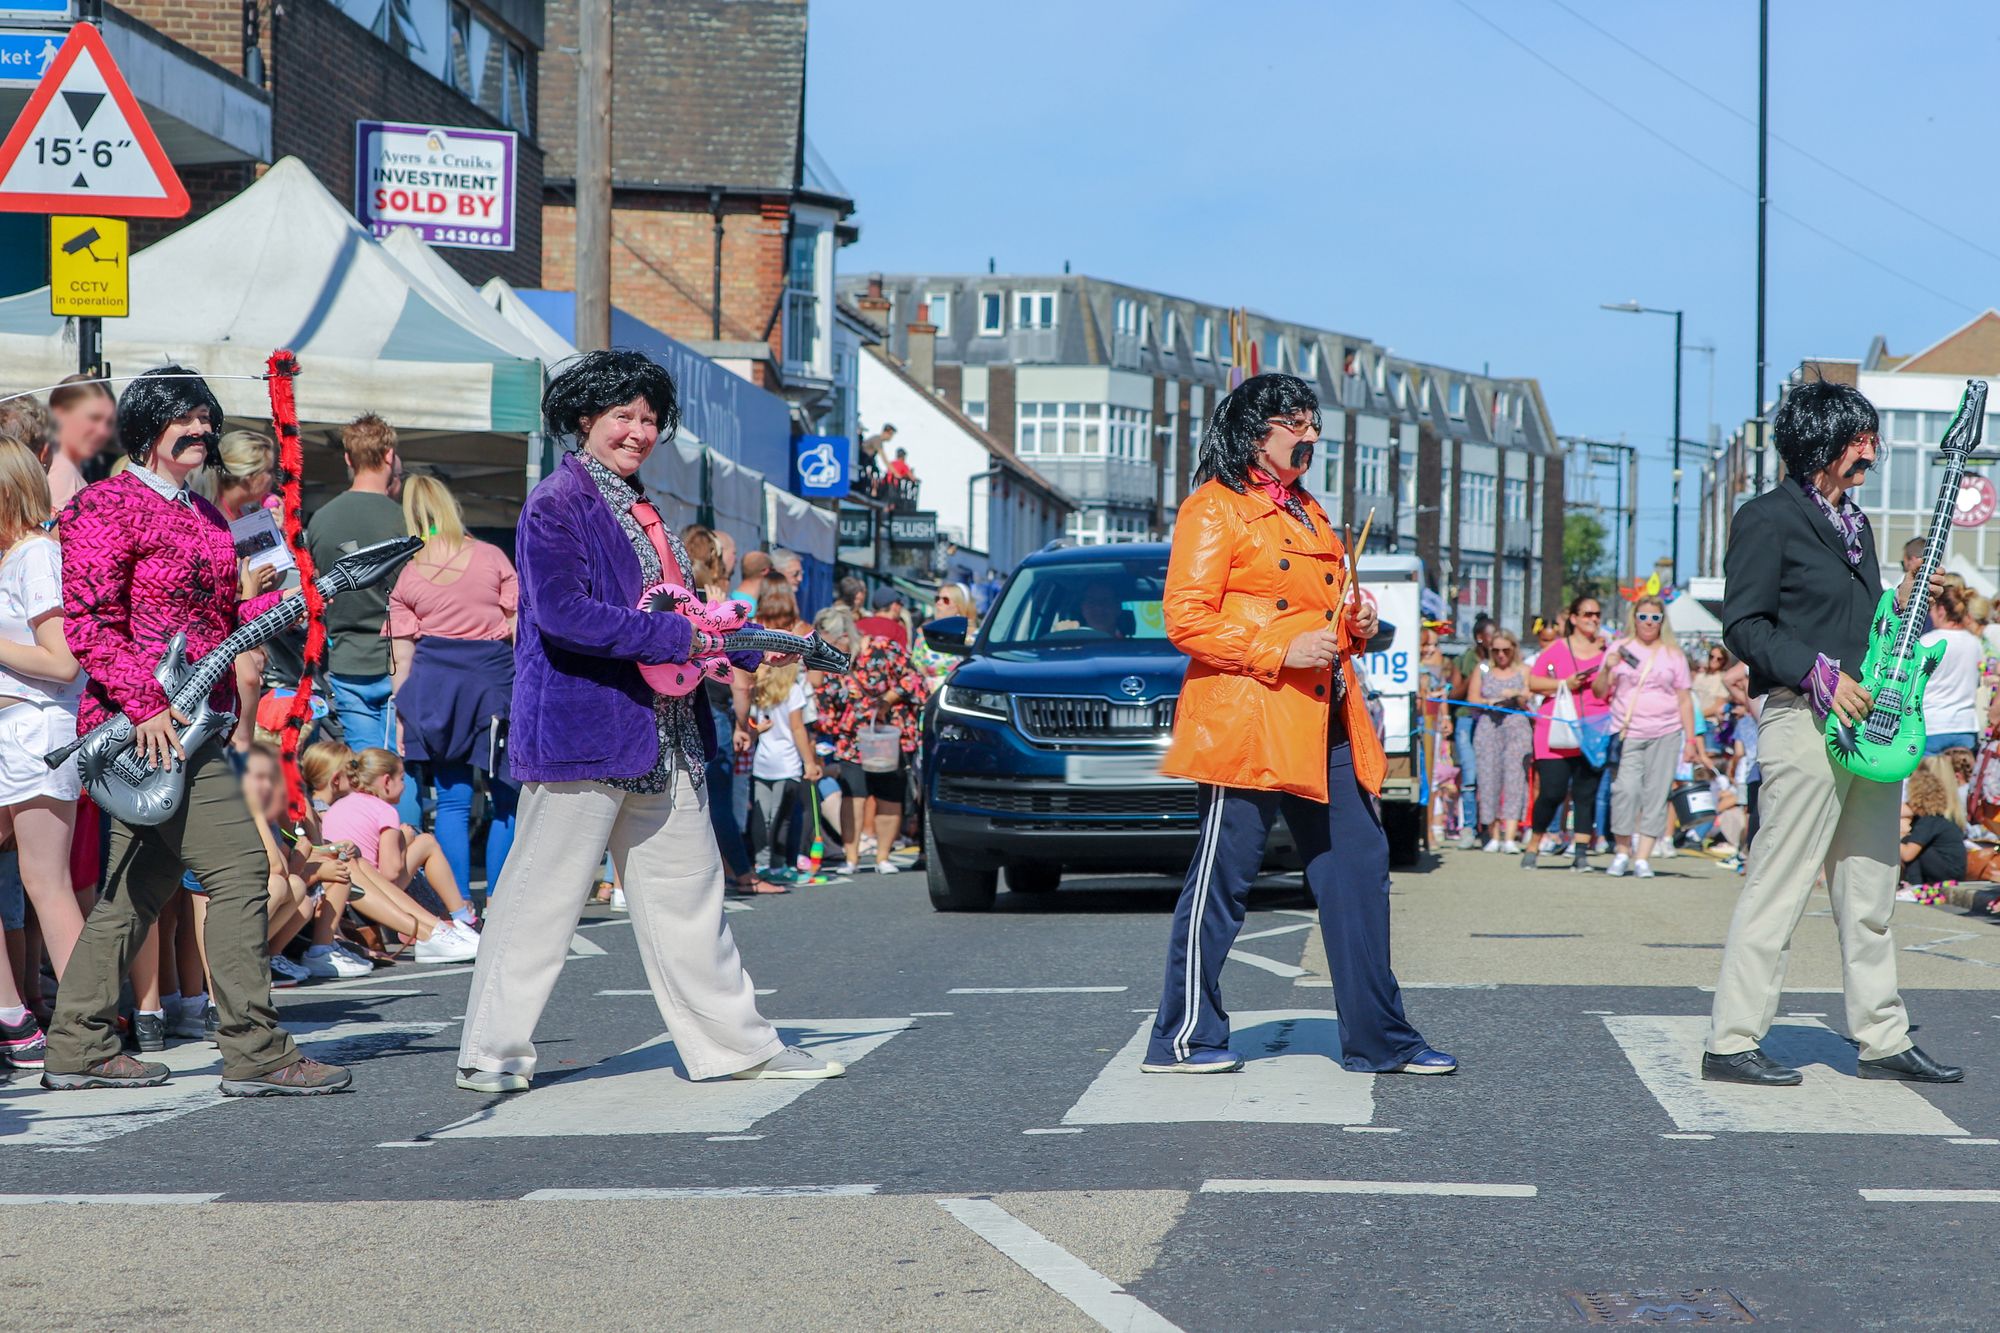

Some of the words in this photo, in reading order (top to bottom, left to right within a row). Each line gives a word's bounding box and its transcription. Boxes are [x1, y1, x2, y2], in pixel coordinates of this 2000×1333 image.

[1, 50, 31, 65] ket
[380, 149, 421, 165] Ayers
[427, 155, 437, 165] &
[442, 153, 493, 169] Cruiks
[373, 167, 497, 190] INVESTMENT
[374, 188, 447, 214] SOLD
[457, 193, 495, 218] BY
[434, 228, 503, 245] 343060
[70, 281, 109, 292] CCTV
[55, 295, 66, 305] in
[69, 296, 124, 307] operation
[891, 521, 935, 538] PLUSH
[1363, 651, 1409, 683] ng
